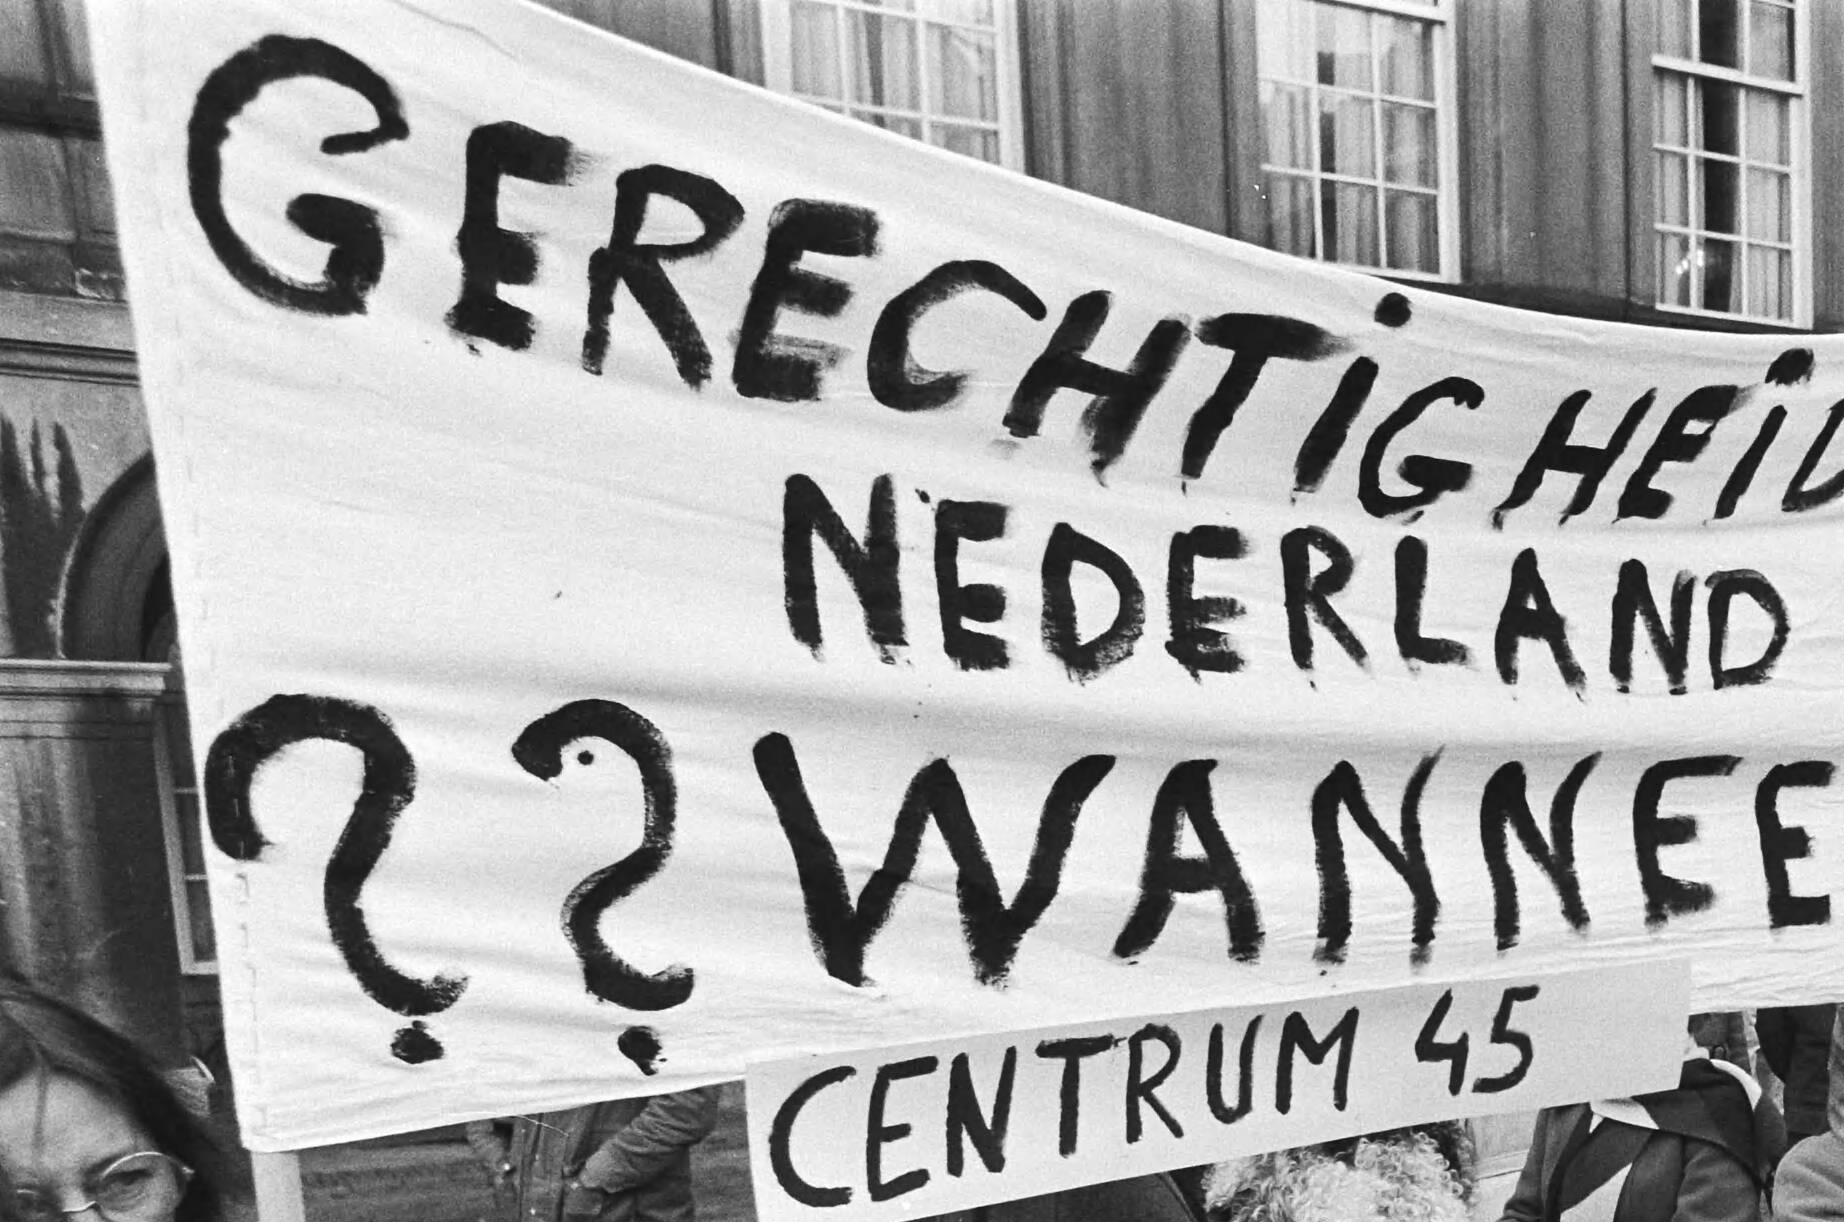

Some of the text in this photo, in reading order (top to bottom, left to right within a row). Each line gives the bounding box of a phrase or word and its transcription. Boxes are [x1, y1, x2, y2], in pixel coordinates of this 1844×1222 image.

[782, 472, 1792, 700] NEDERLAND
[768, 985, 1540, 1208] CENTRUM 45
